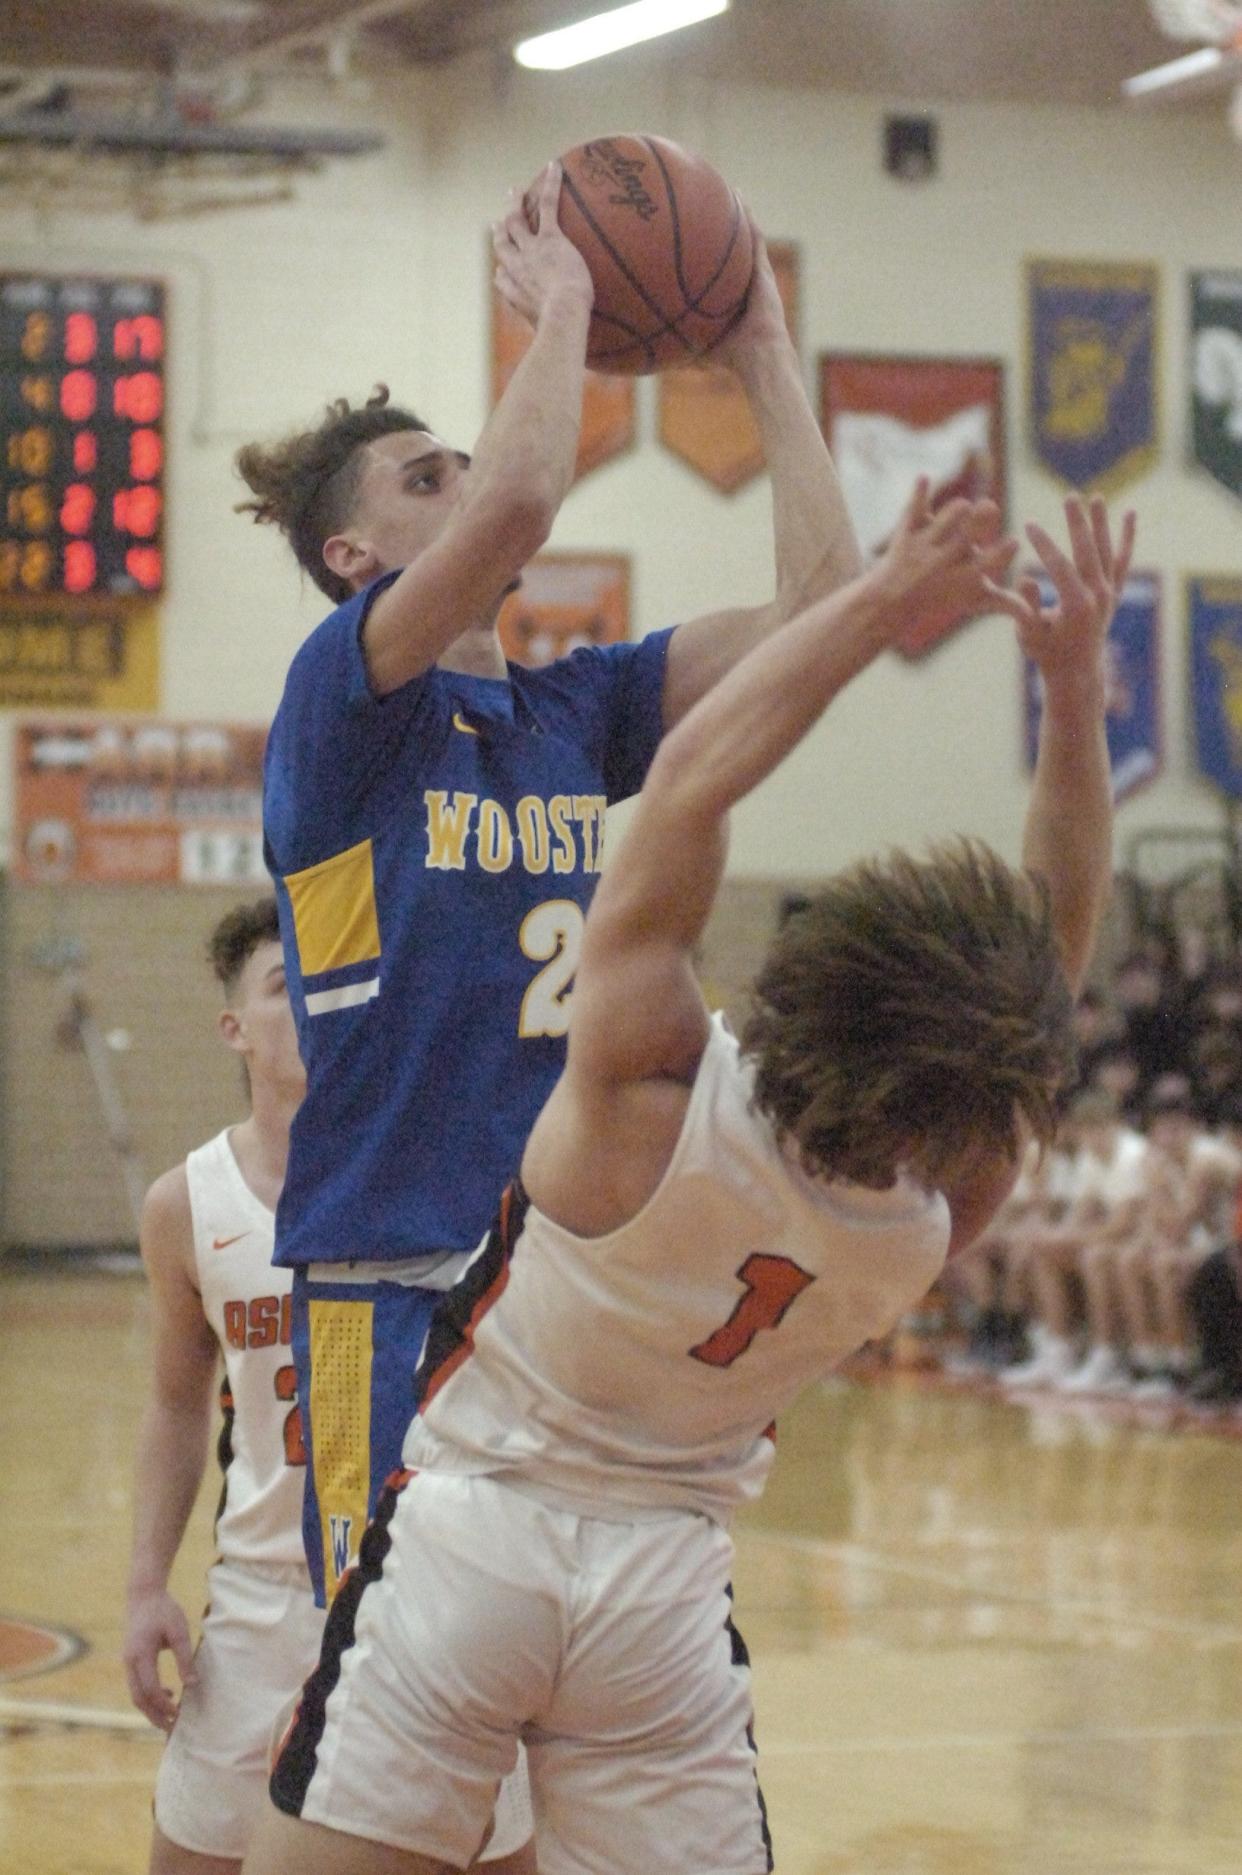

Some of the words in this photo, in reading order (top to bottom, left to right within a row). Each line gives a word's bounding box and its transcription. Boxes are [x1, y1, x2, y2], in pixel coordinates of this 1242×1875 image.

[519, 899, 584, 1038] 2
[688, 1253, 818, 1369] 1
[328, 1514, 352, 1578] W
